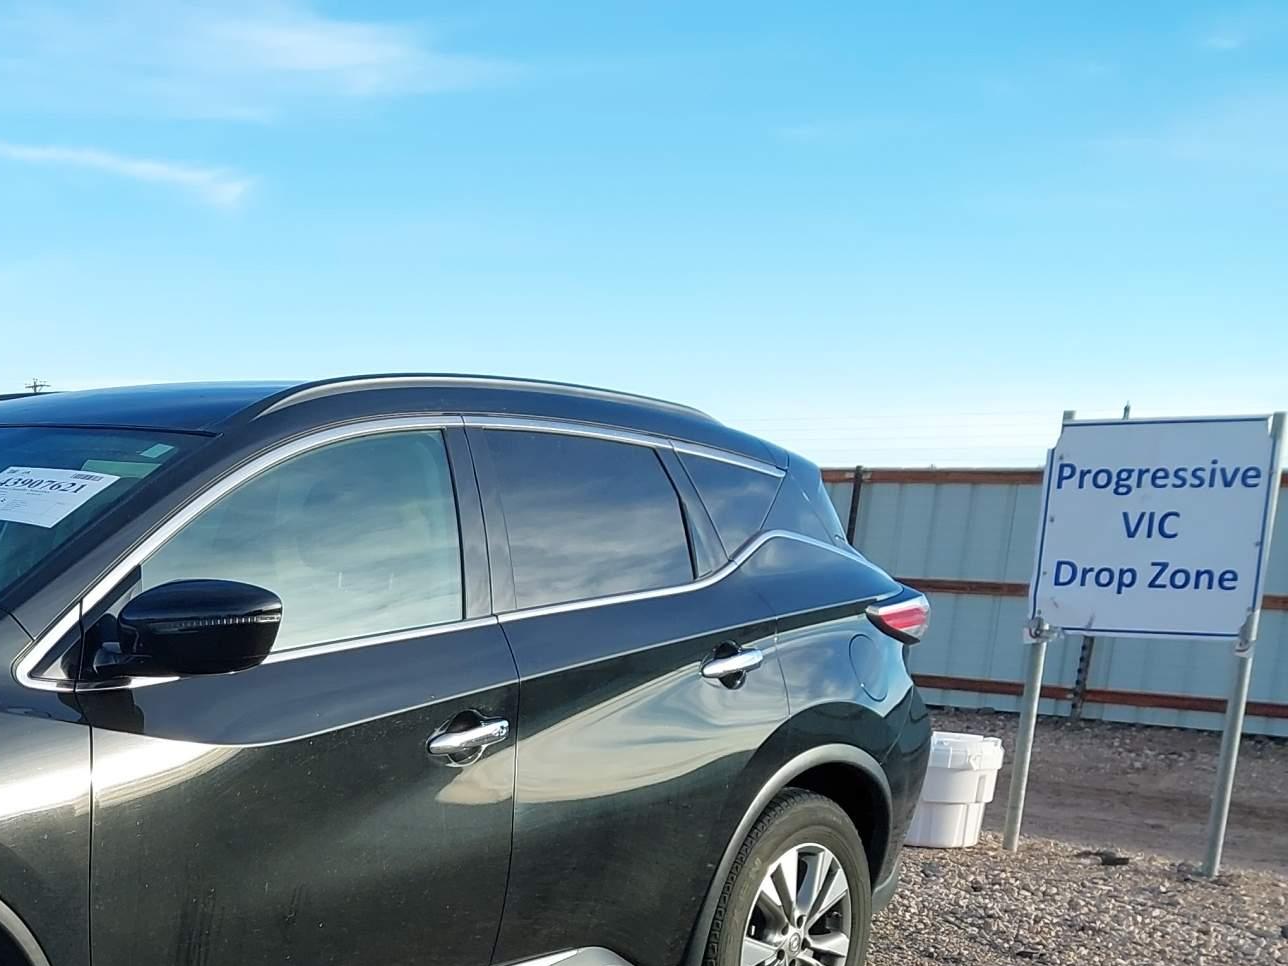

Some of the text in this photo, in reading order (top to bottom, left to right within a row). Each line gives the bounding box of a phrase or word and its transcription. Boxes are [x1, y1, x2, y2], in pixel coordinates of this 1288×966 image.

[1055, 459, 1263, 496] Progressive
[1121, 511, 1181, 540] VIC
[1053, 560, 1239, 595] Drop Zone
